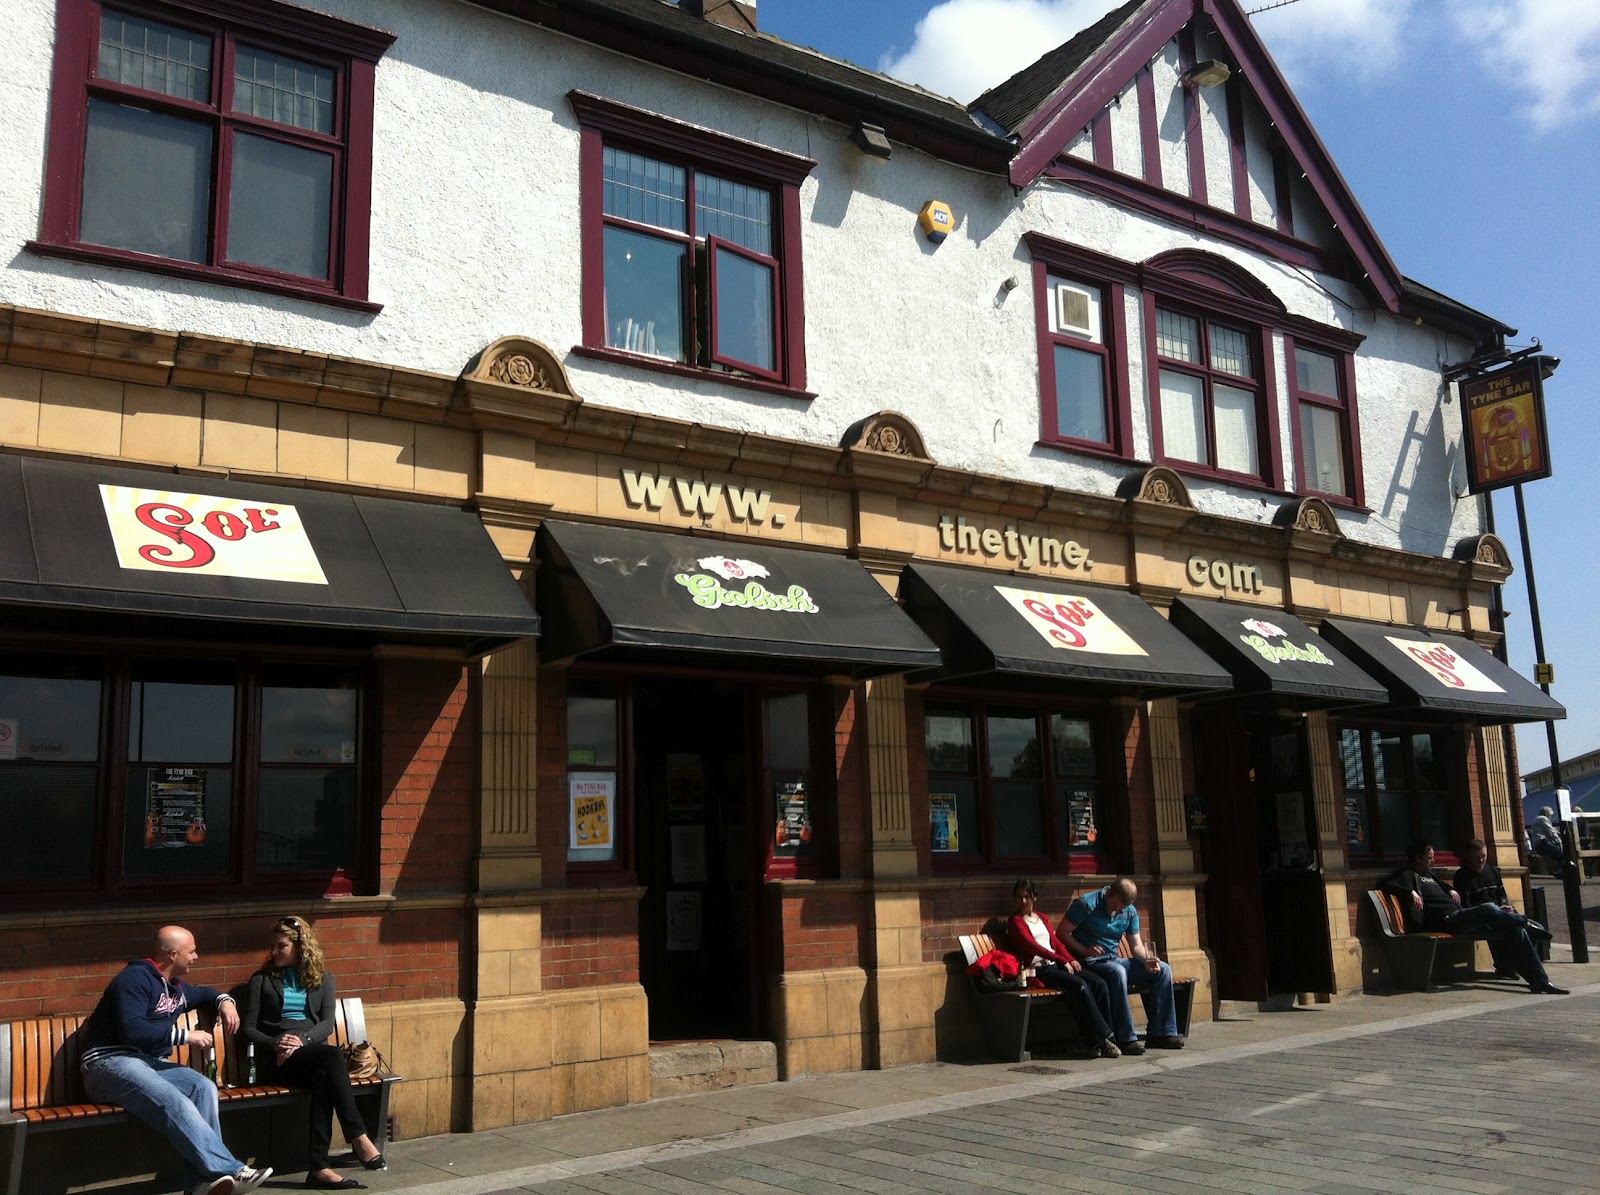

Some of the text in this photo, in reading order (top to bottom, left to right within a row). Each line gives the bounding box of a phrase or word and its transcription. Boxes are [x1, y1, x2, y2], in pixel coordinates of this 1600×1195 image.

[934, 210, 948, 224] ADT
[1470, 381, 1531, 406] TYNE BAR
[1488, 376, 1512, 391] THE
[1184, 555, 1264, 594] com
[674, 573, 819, 614] Grolsch
